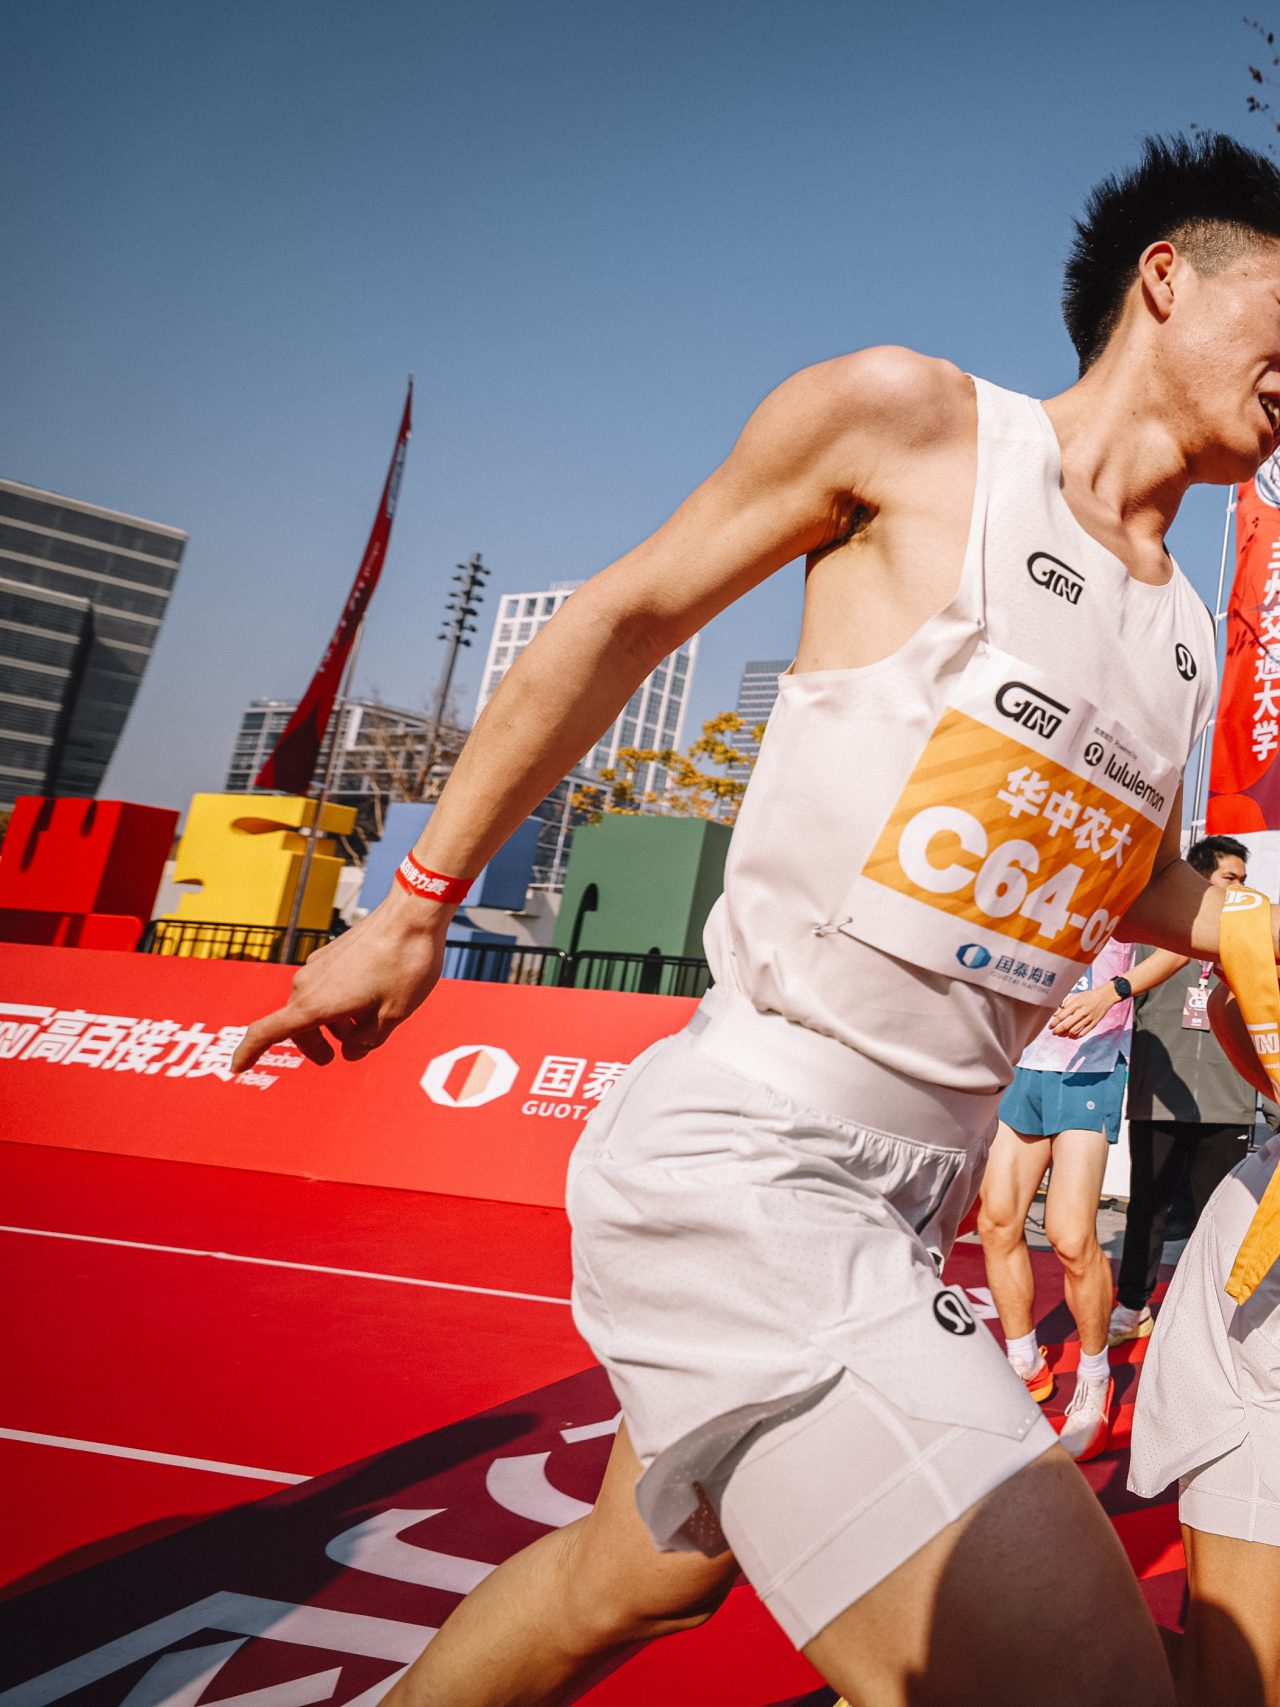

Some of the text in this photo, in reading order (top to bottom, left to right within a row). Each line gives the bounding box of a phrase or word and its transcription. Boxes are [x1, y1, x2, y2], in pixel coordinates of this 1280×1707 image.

[1103, 753, 1165, 812] lululemon
[997, 766, 1133, 869] 华中农大
[995, 955, 1056, 987] 国泰海通
